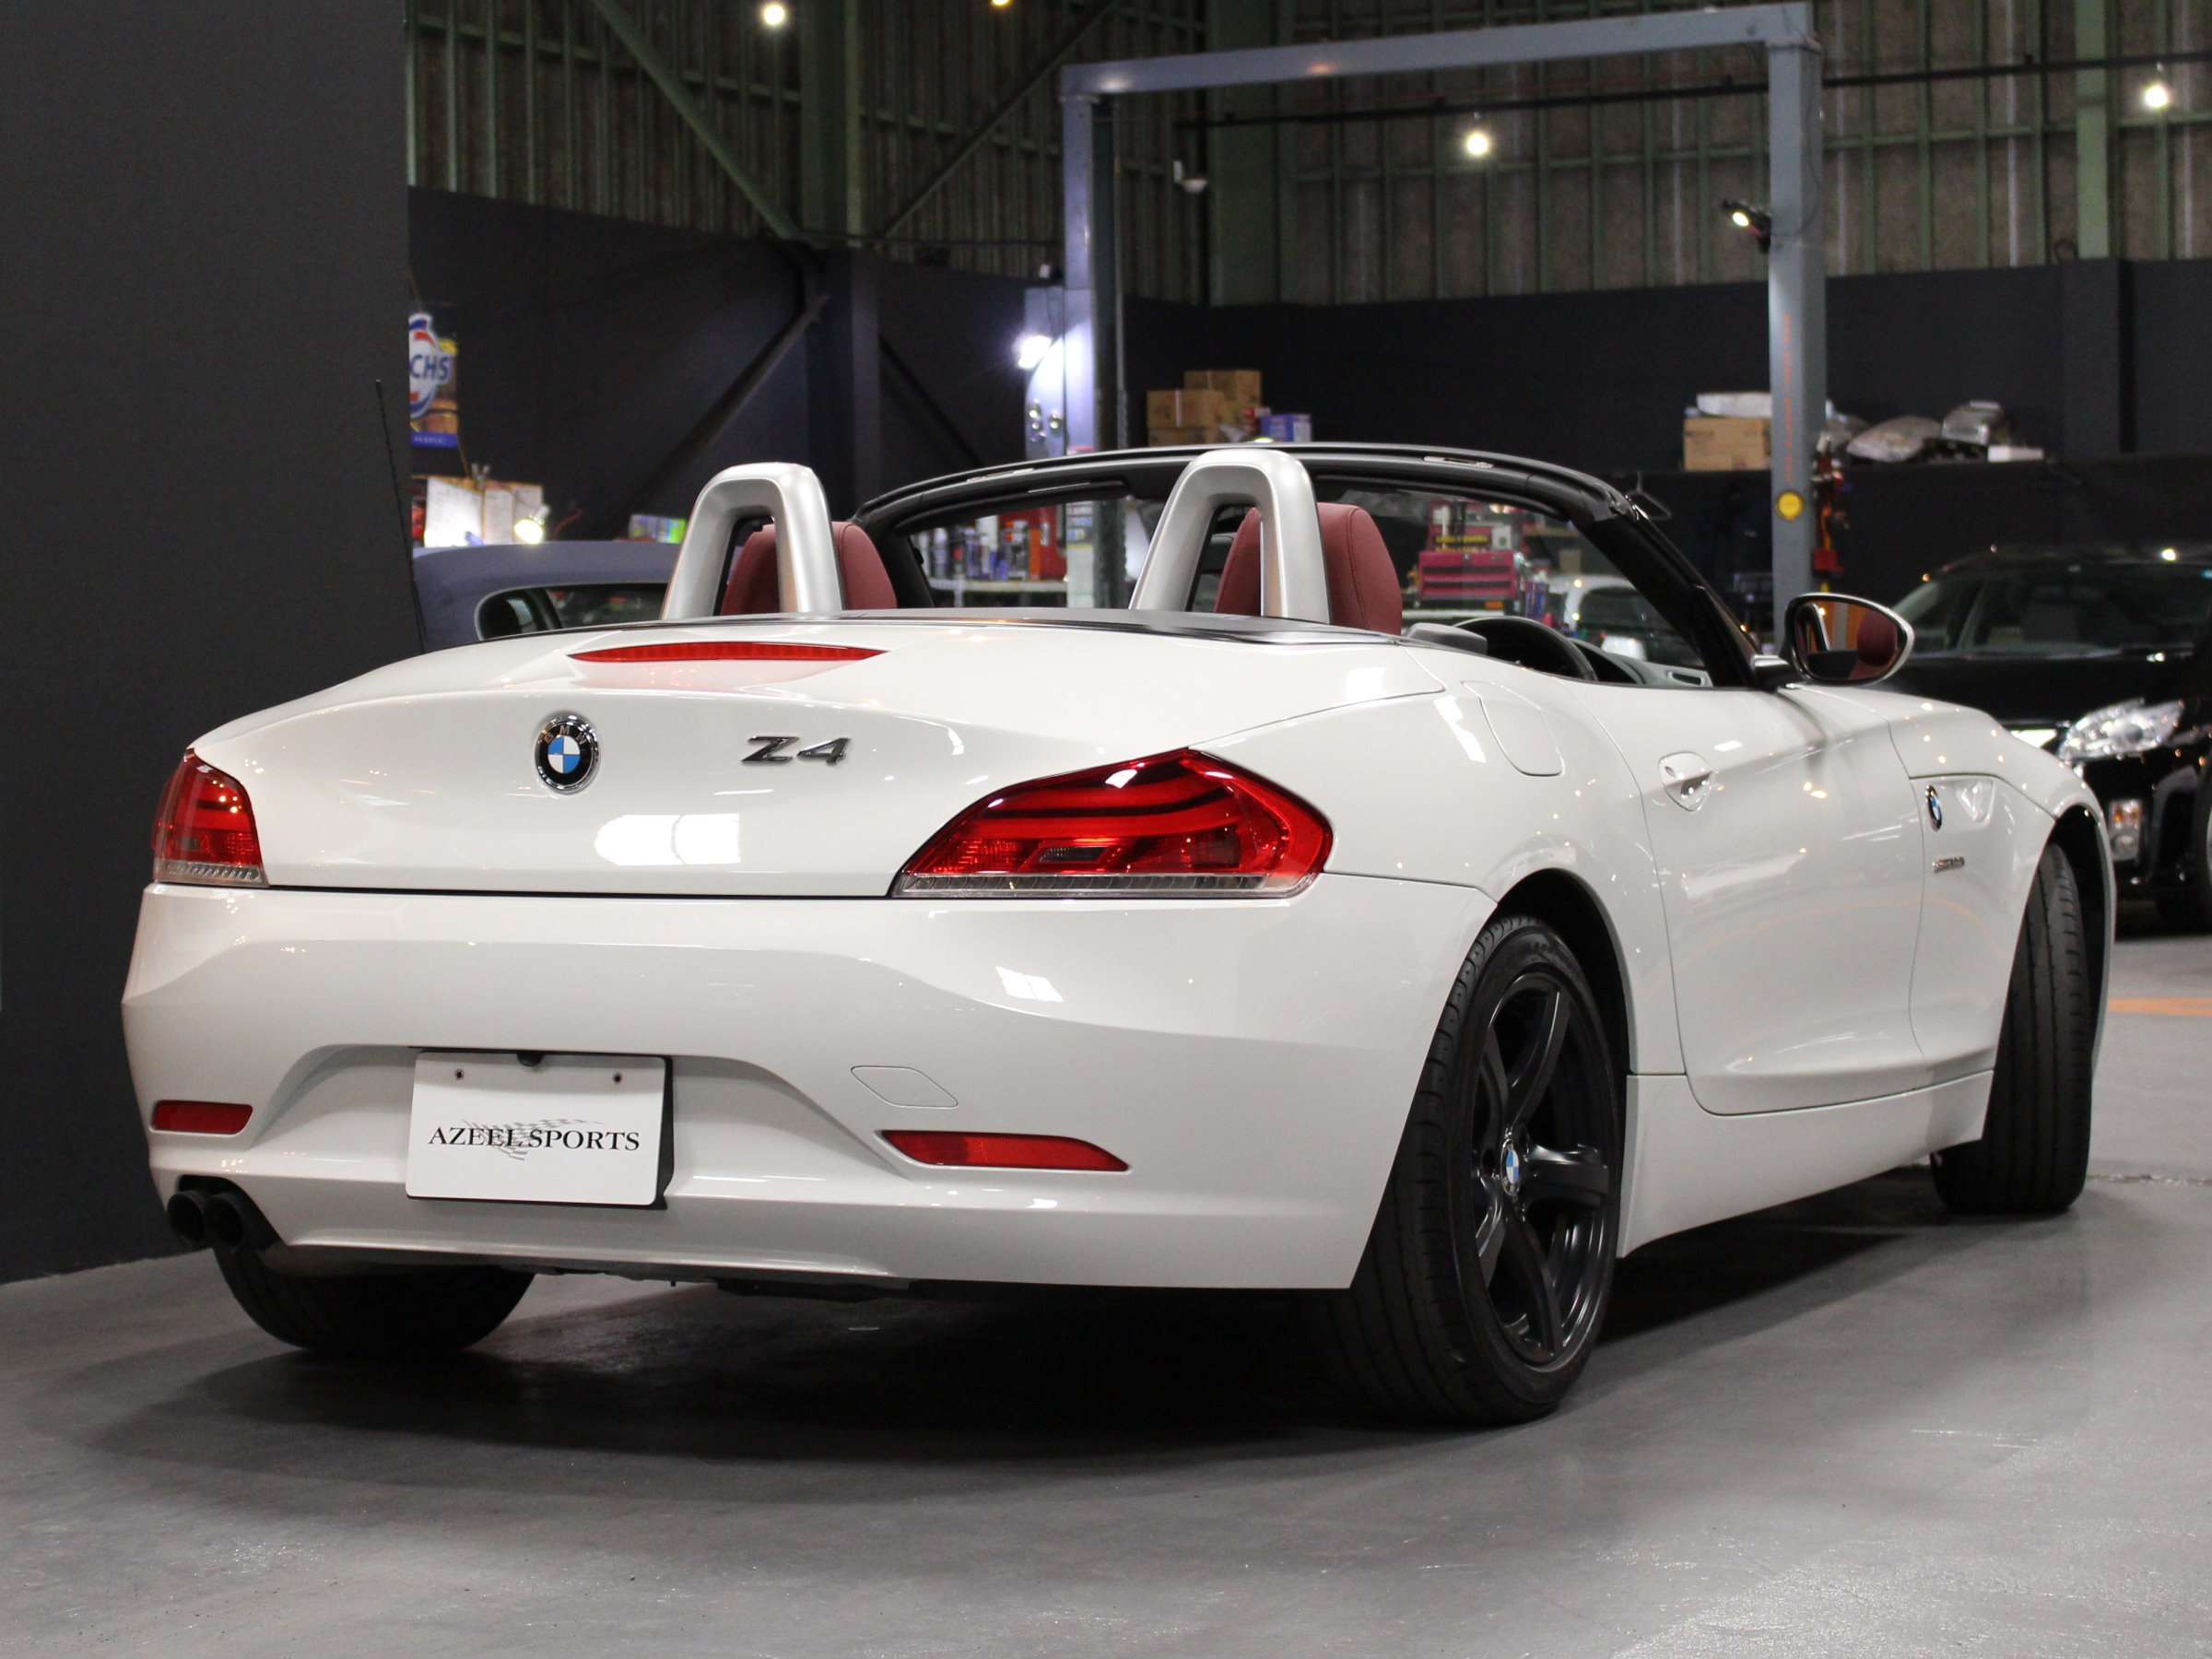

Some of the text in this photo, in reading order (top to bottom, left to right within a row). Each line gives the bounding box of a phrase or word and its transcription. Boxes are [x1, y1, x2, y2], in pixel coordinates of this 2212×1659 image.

[544, 724, 587, 746] BMW
[741, 735, 851, 764] Z4
[428, 1125, 640, 1151] AZEEL SPORTS
